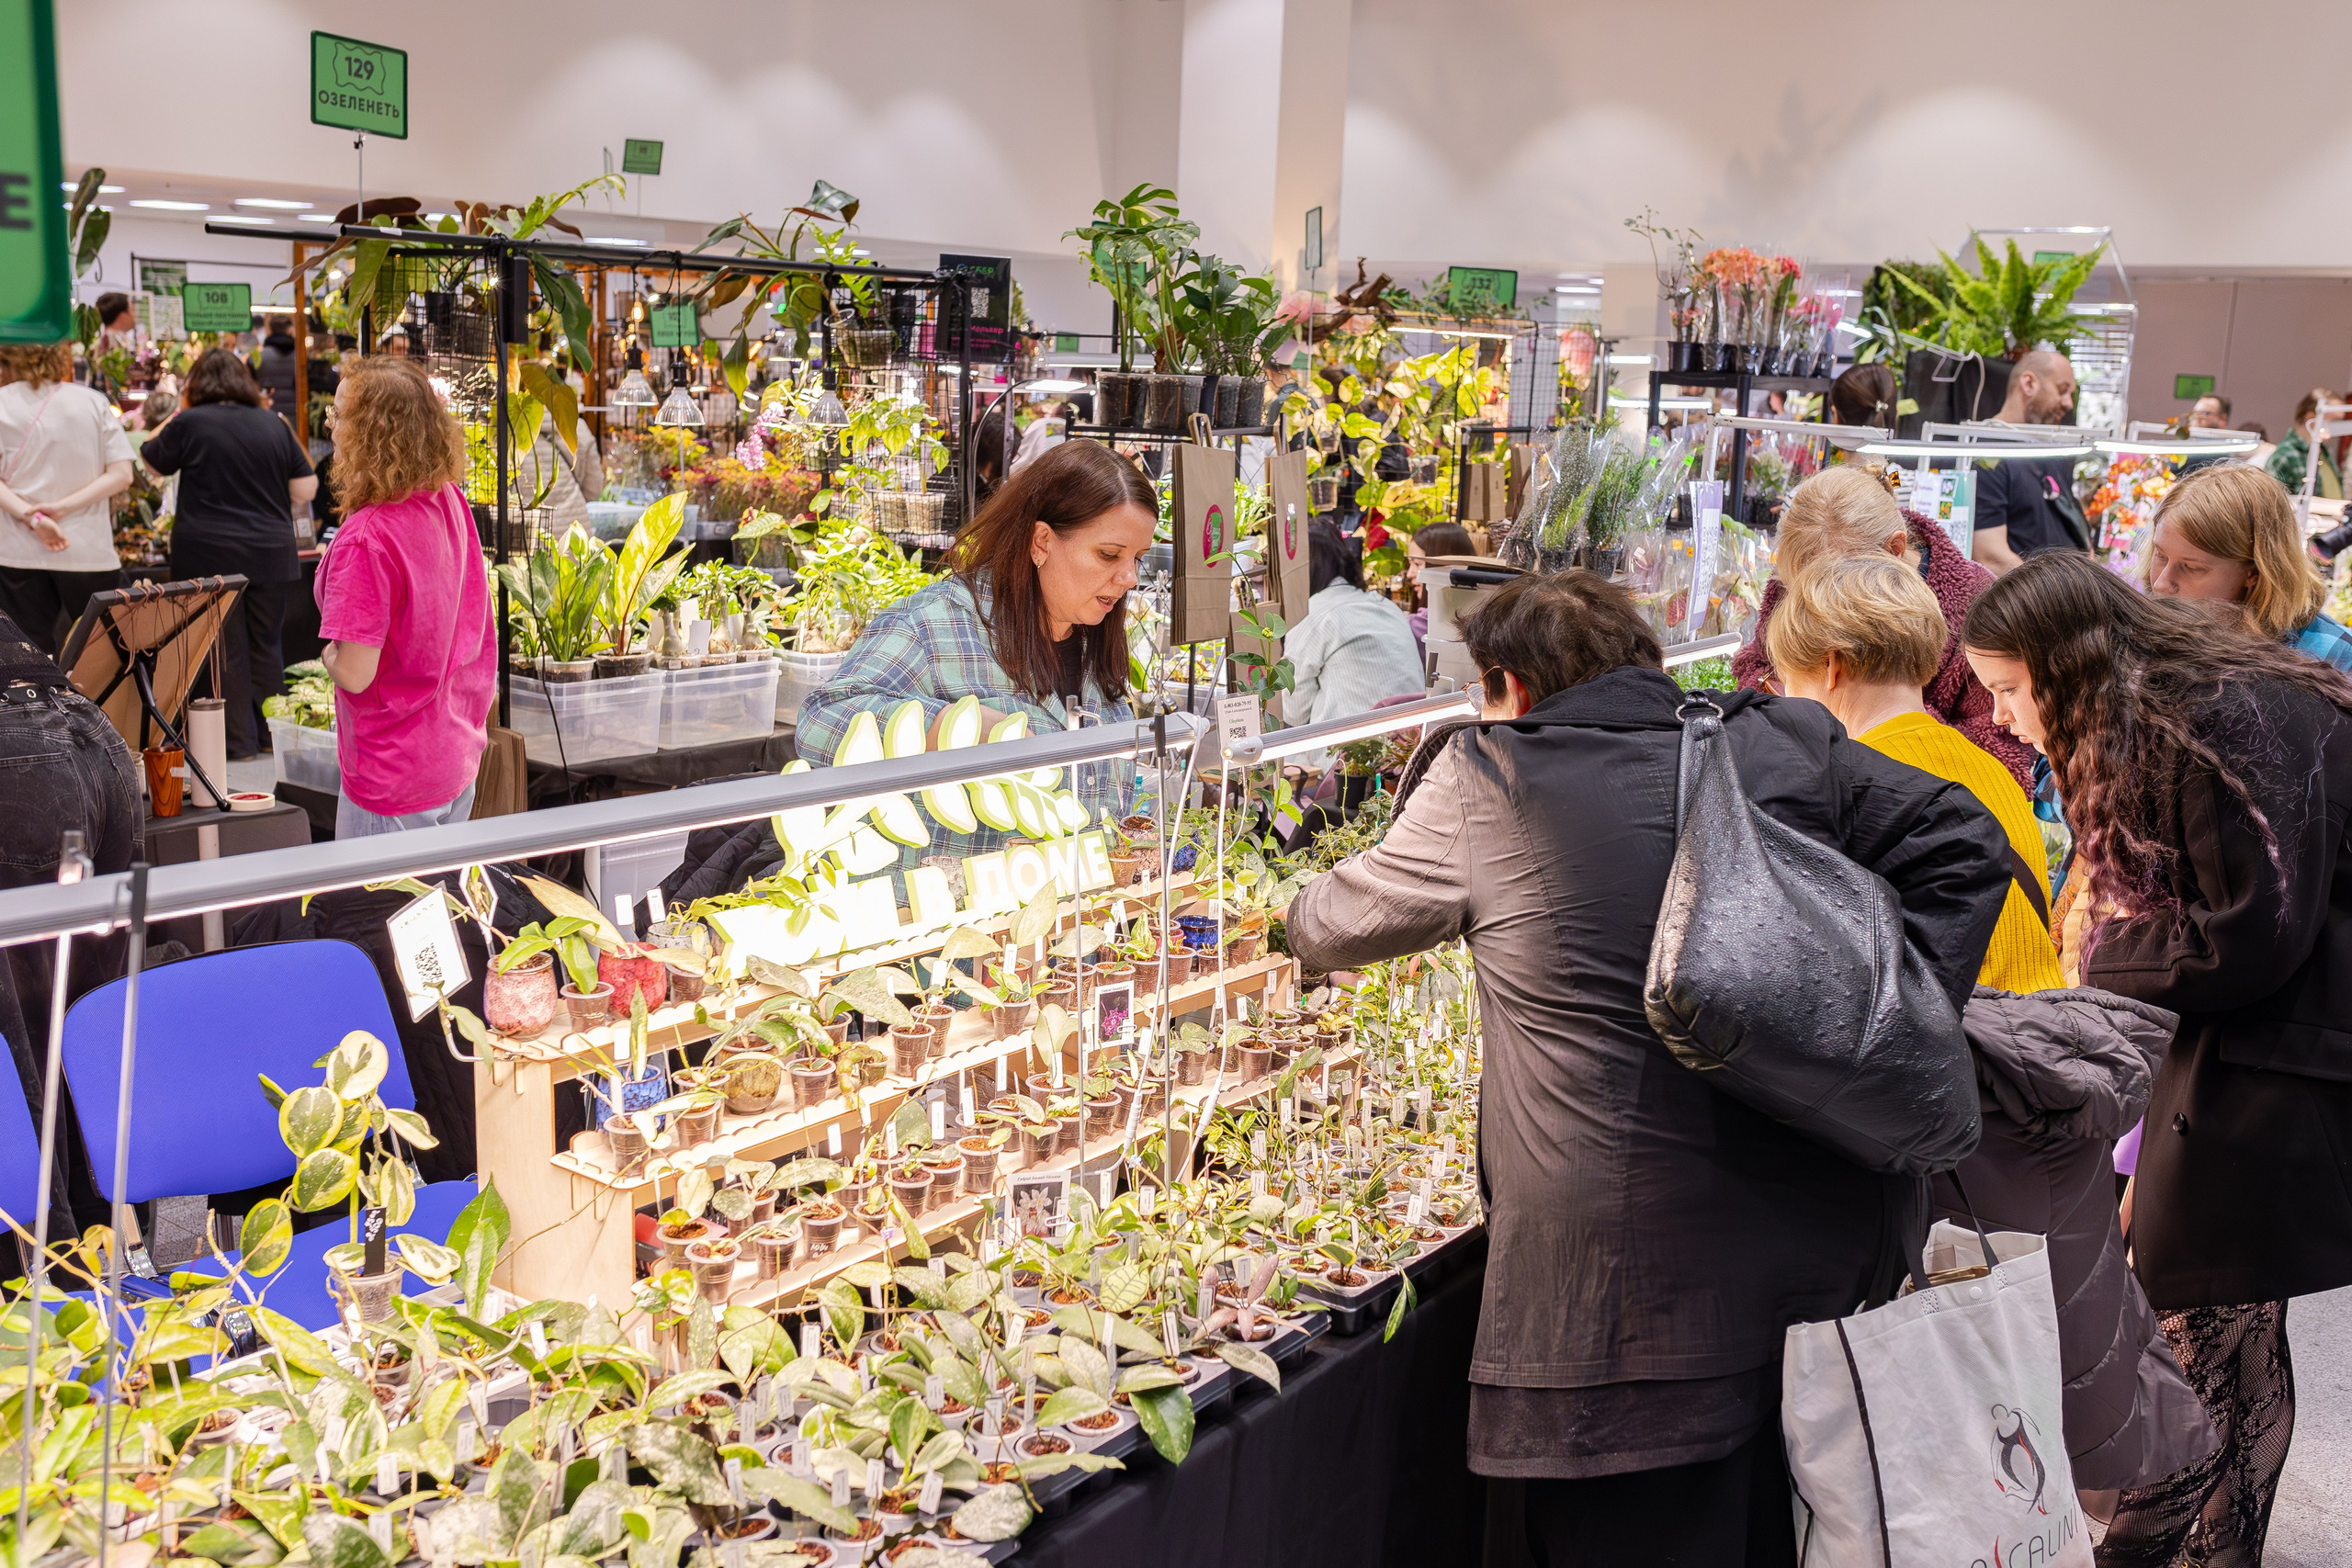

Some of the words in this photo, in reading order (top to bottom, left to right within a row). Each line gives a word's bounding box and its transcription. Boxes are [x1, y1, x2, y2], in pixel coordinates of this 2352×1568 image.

[345, 56, 374, 81] 129
[318, 89, 400, 118] ОЗЕЛЕНЕТЬ
[970, 835, 1114, 916] ДОМЕ
